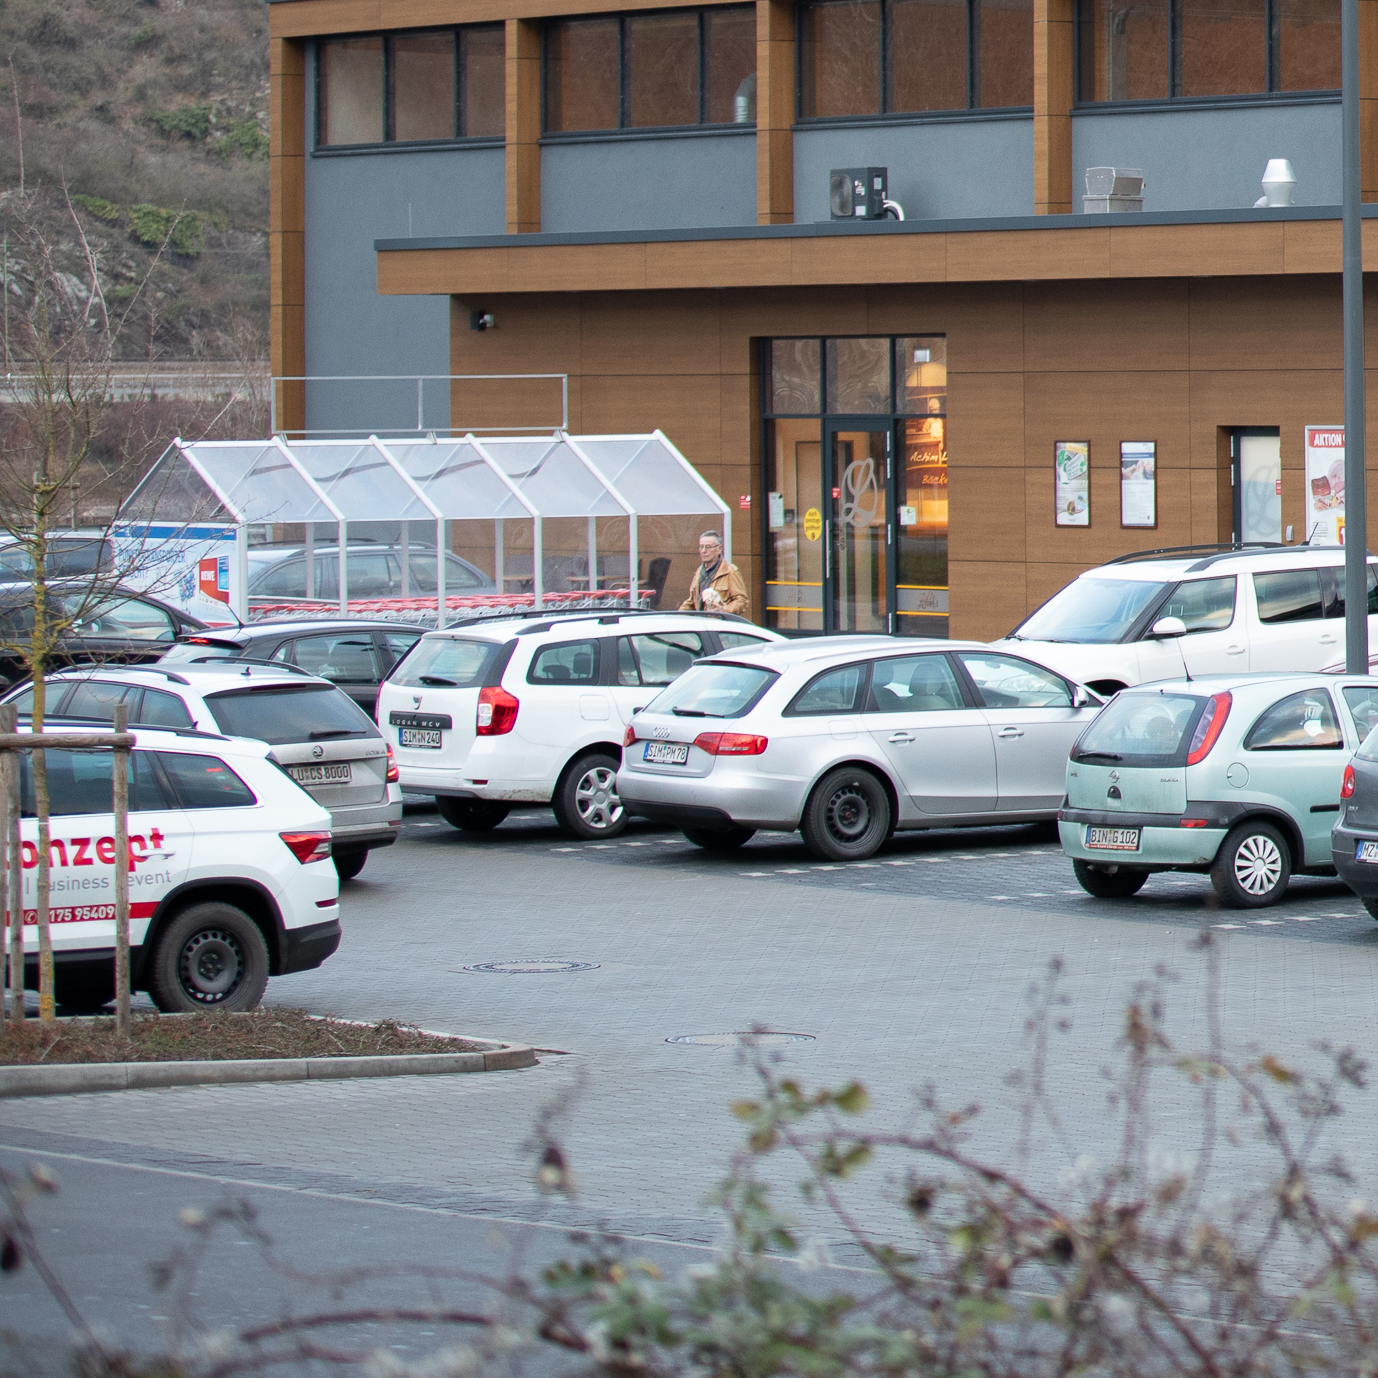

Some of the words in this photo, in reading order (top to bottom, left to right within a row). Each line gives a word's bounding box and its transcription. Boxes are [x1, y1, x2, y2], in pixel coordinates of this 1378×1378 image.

[1314, 433, 1341, 446] AKTION
[910, 452, 938, 463] Achim
[403, 730, 417, 742] SIM
[648, 742, 662, 757] SIM
[311, 766, 323, 780] CS
[326, 765, 348, 779] 8000
[1092, 830, 1108, 843] BIN
[20, 828, 164, 872] onzept
[1363, 843, 1375, 858] MZ
[128, 870, 171, 887] event
